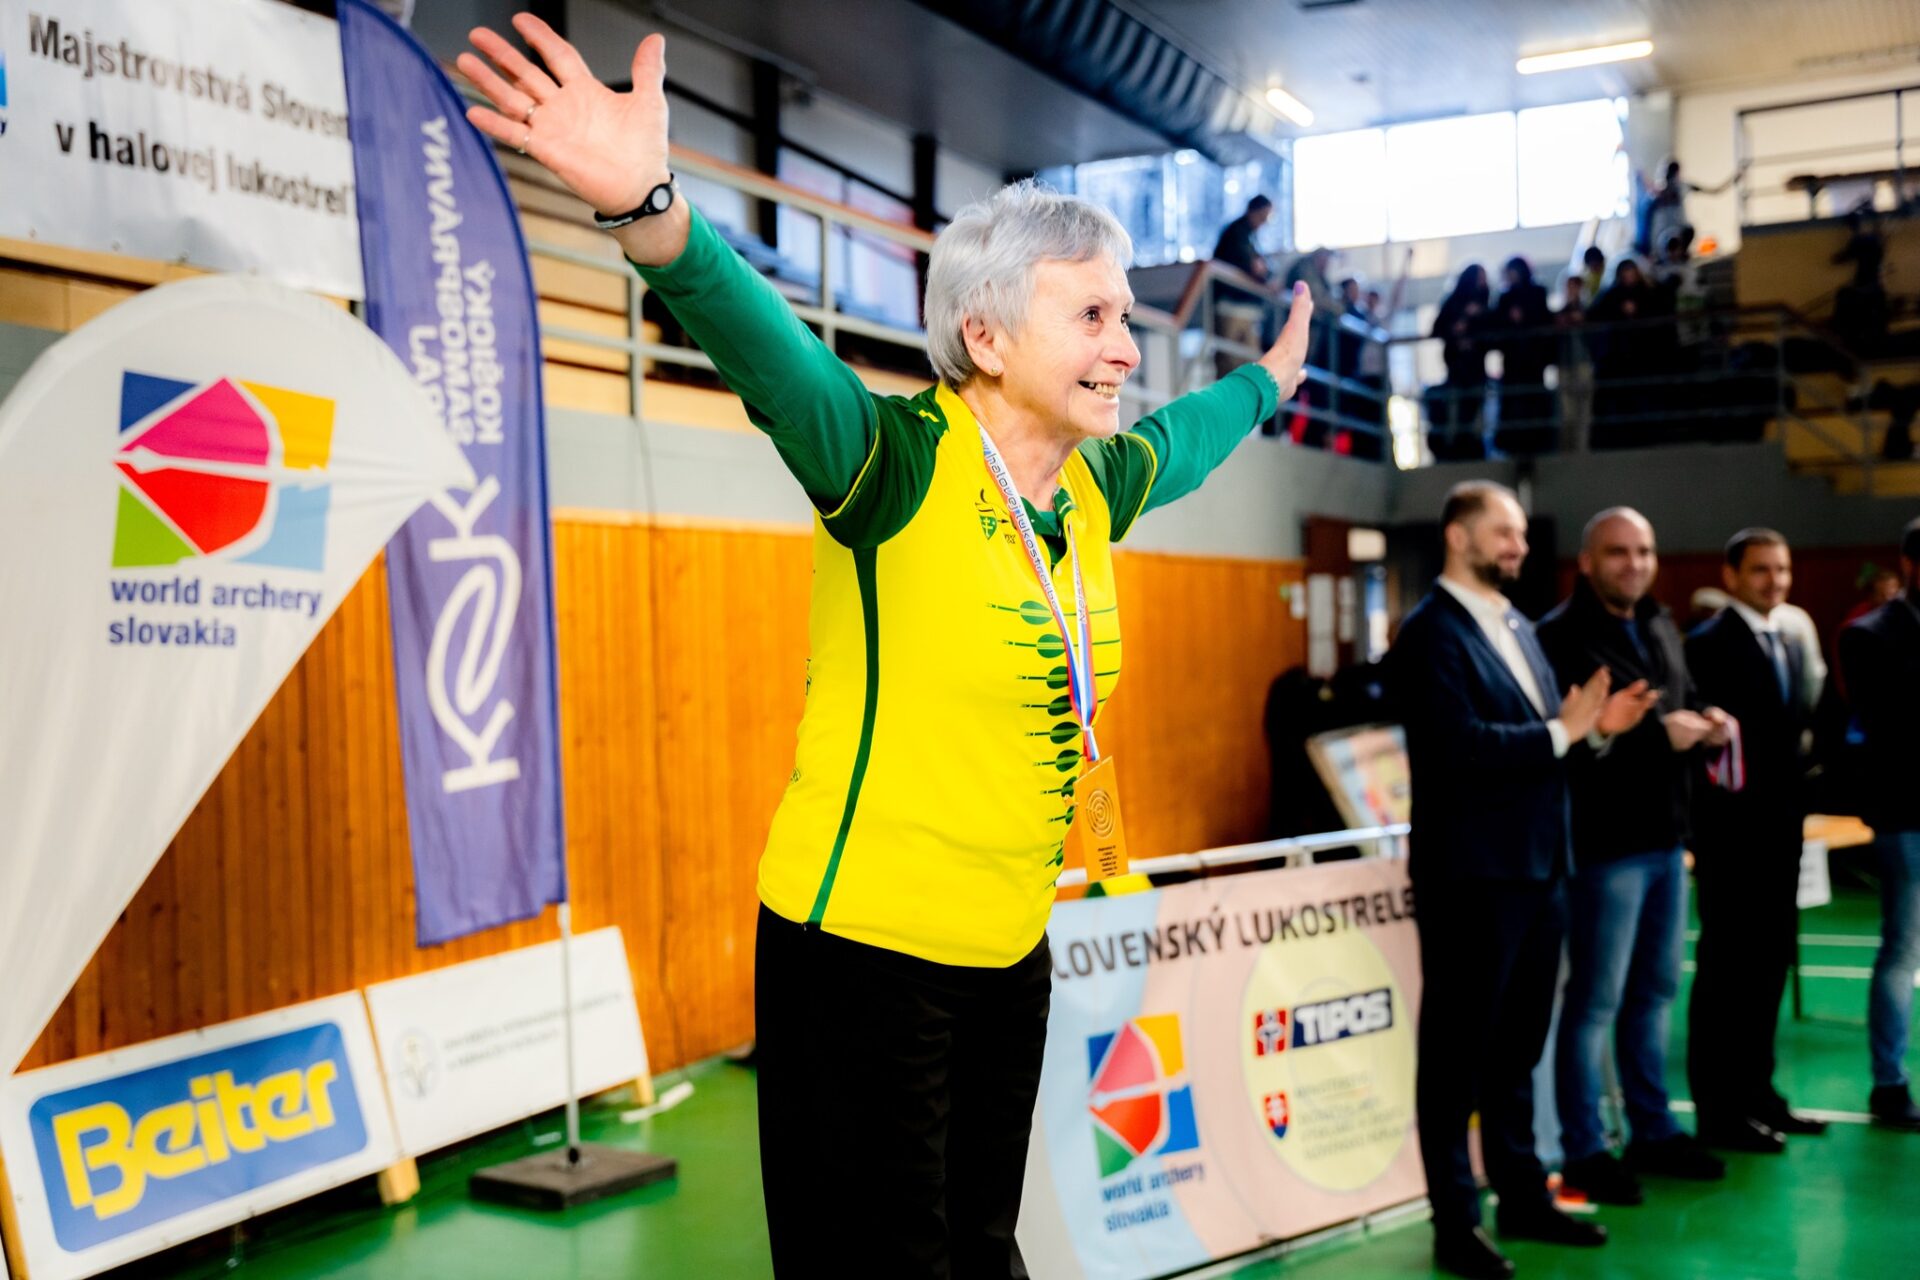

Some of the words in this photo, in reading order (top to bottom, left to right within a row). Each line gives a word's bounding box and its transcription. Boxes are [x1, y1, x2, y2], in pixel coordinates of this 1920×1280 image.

[29, 13, 250, 112] Majstrovstvá
[56, 121, 74, 153] v
[89, 120, 217, 192] halovej
[986, 452, 1021, 512] halovej
[111, 576, 200, 605] world
[211, 580, 322, 618] archery
[109, 616, 236, 647] slovakia
[1294, 989, 1391, 1045] TIPOS
[52, 1059, 338, 1221] Beiter
